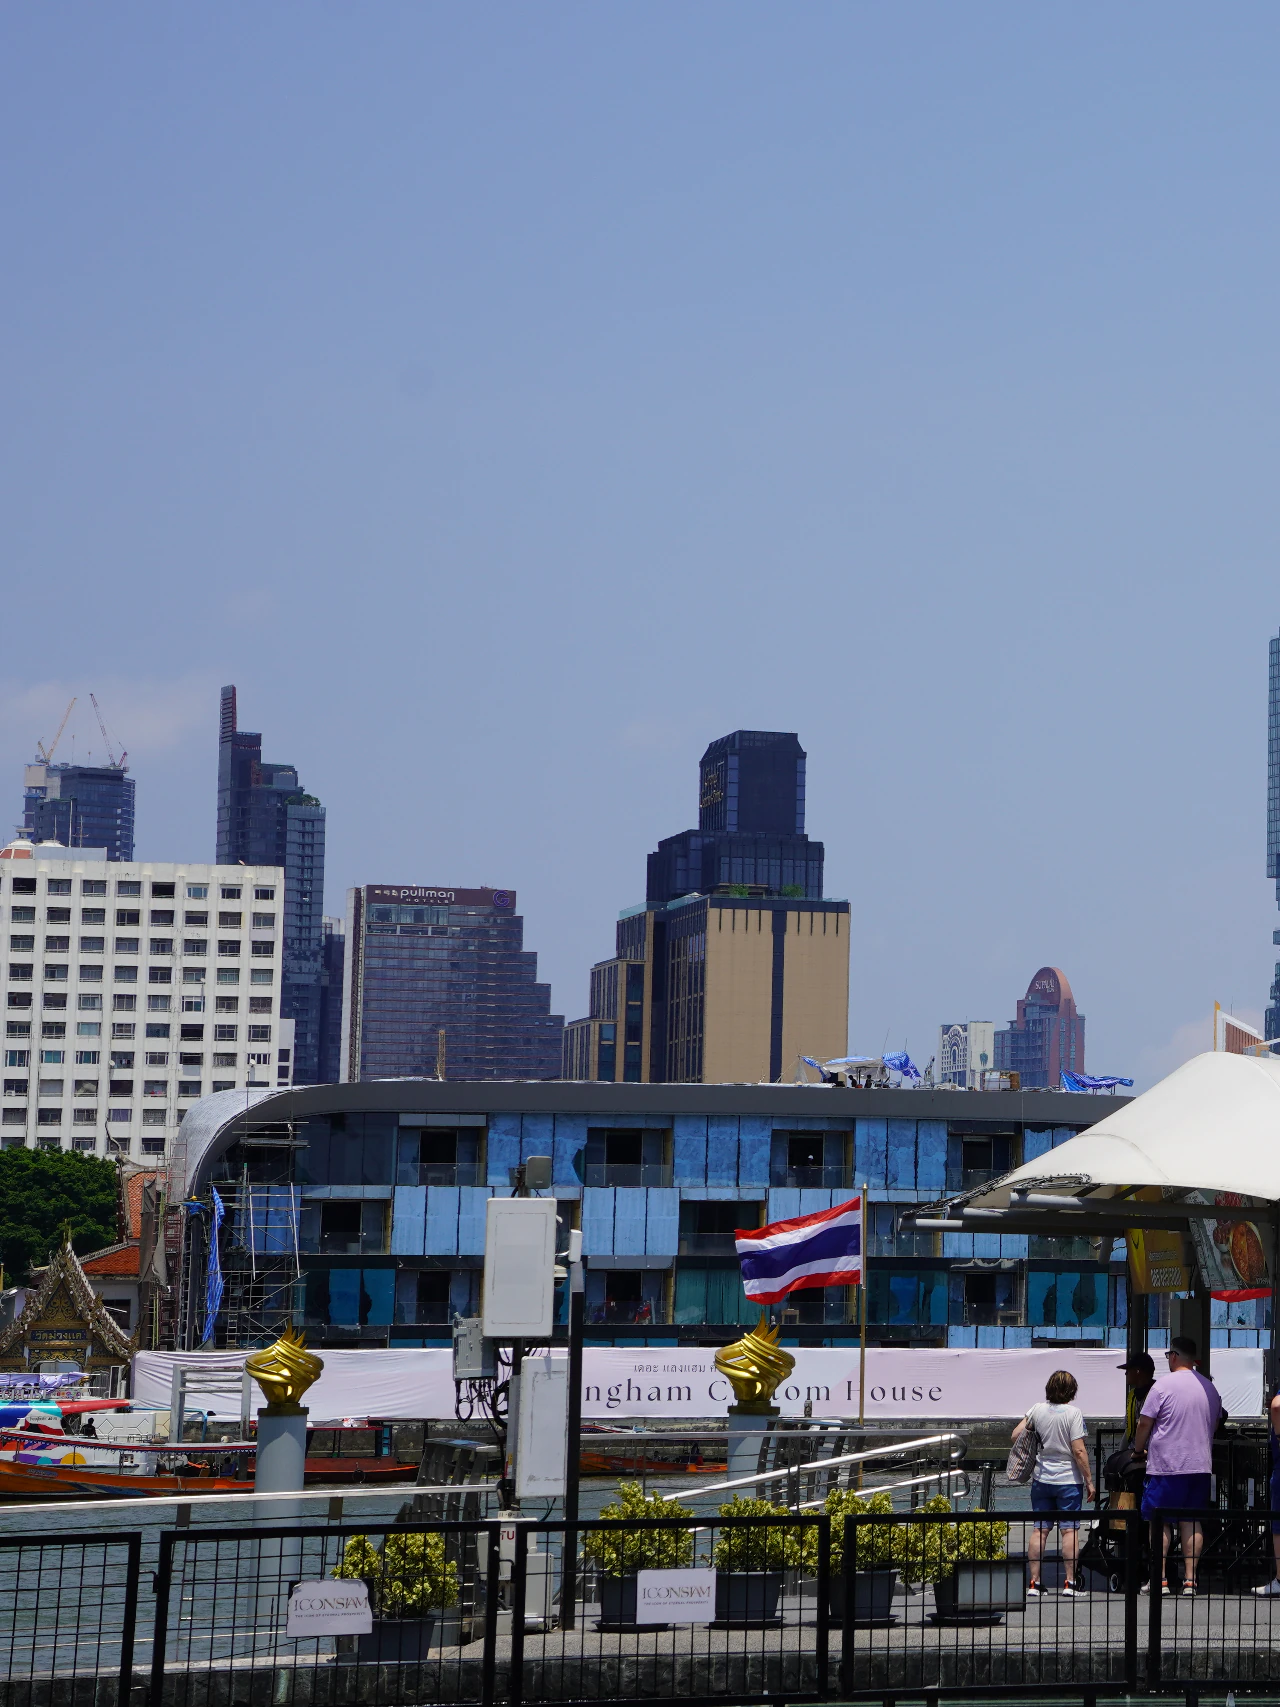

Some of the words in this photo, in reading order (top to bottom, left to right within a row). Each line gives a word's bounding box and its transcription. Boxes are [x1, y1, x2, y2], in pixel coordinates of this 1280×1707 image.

[400, 888, 455, 902] pullman
[584, 1377, 693, 1409] ngham
[708, 1380, 831, 1402] Ctom
[846, 1379, 943, 1402] House
[642, 1585, 711, 1599] ICONSIAM
[293, 1597, 368, 1611] ICONSIAM
